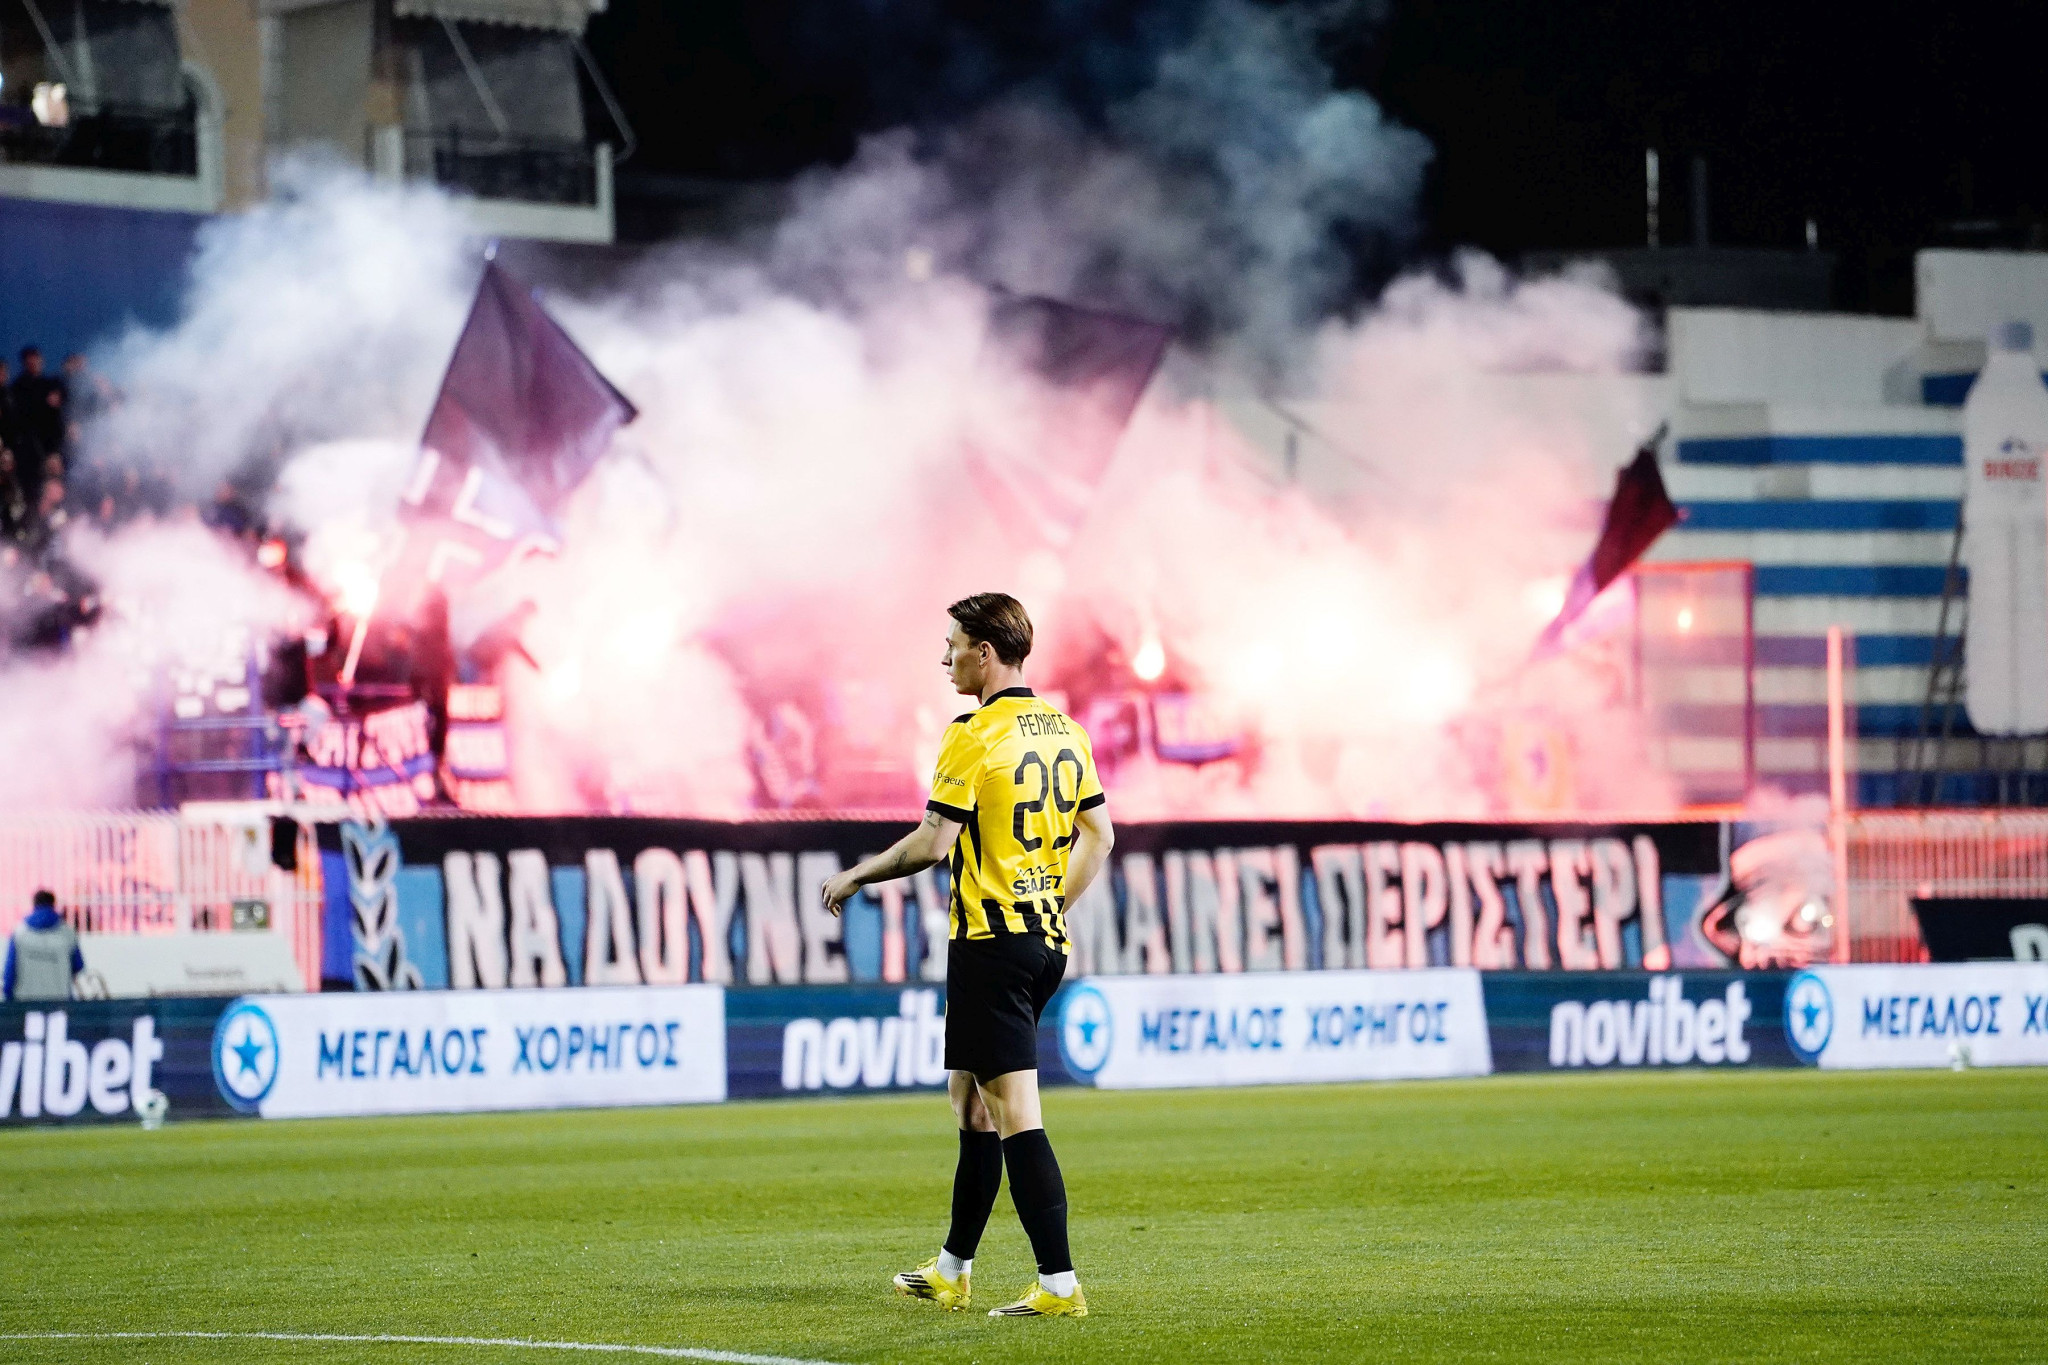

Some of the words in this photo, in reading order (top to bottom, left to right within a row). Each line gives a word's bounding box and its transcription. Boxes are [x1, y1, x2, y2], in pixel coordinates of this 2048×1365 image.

[1016, 713, 1070, 738] PENRICE
[936, 772, 966, 787] Praeus
[1012, 874, 1064, 896] SEAJET
[443, 848, 567, 988] ΝΑ
[584, 846, 849, 985] ΔΟΥΝΕ
[1063, 844, 1311, 976] ΜΑΙΝΕΙ
[1311, 834, 1672, 972] ΠΕΡΙΣΤΕΡΙ
[781, 988, 948, 1090] novib
[1549, 975, 1752, 1067] novibet
[1861, 994, 2003, 1039] ΜΕΓΑΛΟΣ
[2023, 994, 2048, 1036] Χ
[316, 1027, 490, 1079] ΜΕΓΑΛΟΣ
[511, 1021, 682, 1074] ΧΟΡΗΓΟΣ
